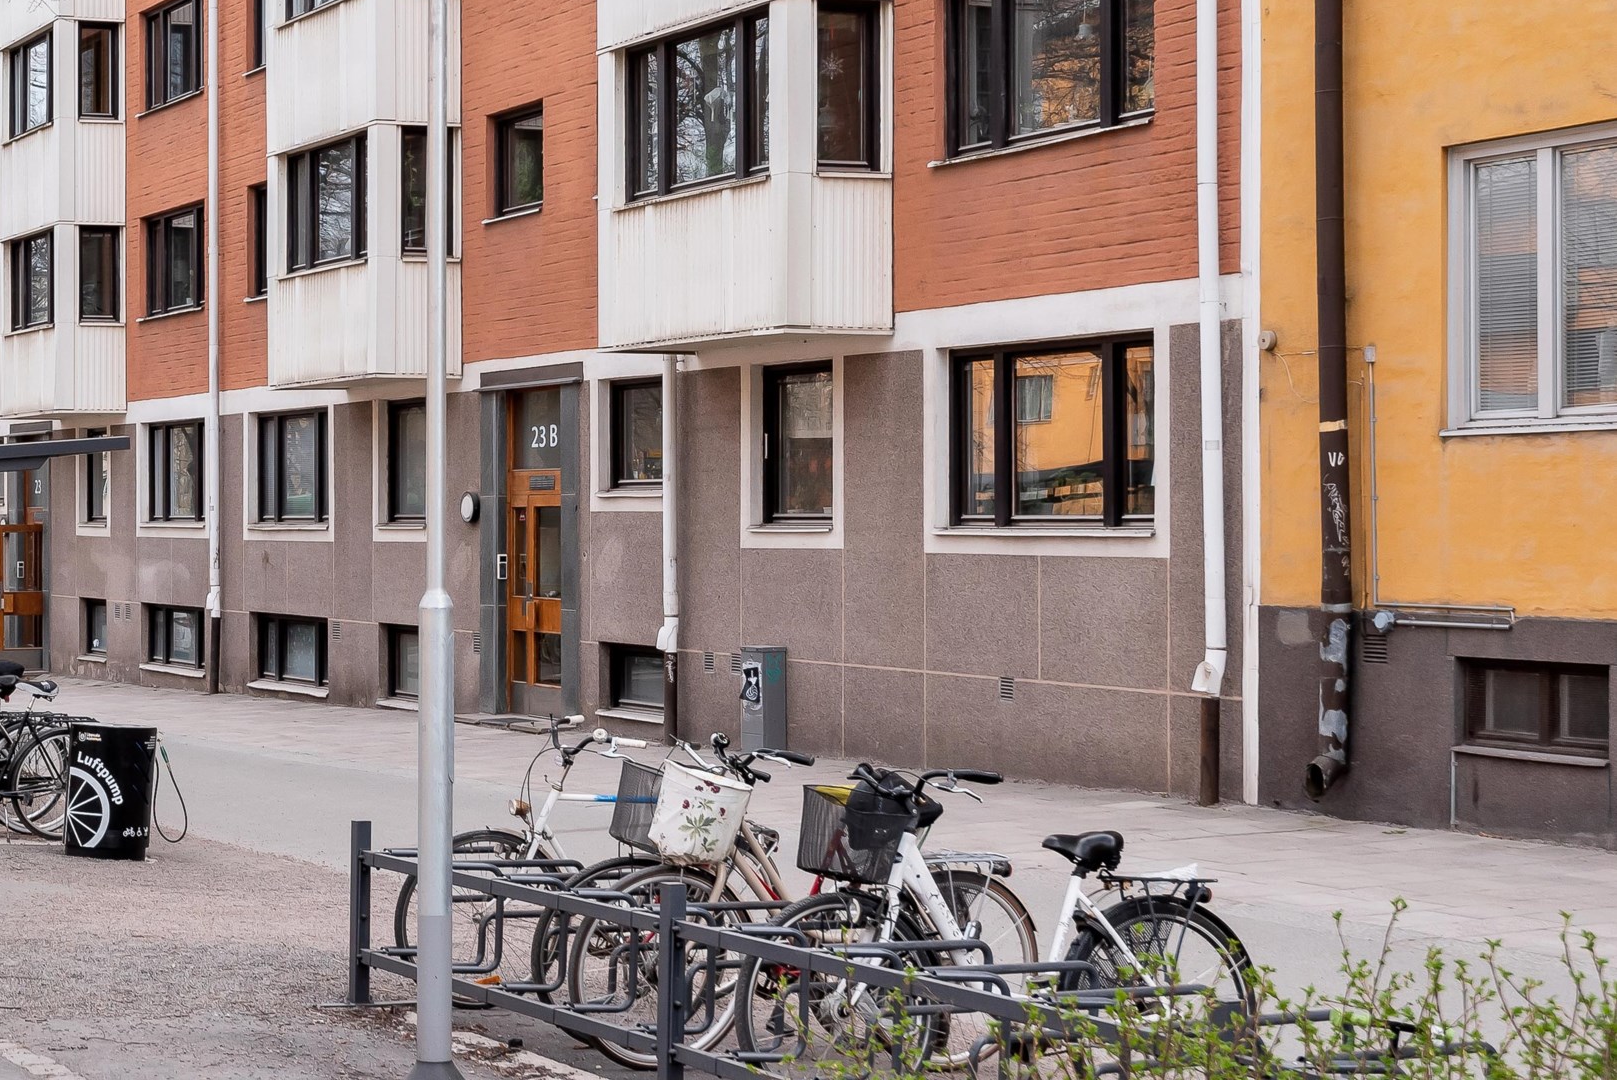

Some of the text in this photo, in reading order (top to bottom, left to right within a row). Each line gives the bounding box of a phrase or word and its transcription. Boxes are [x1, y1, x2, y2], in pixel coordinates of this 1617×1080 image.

[531, 424, 558, 448] 23 B
[34, 479, 42, 494] 23
[76, 750, 124, 805] Luftpump
